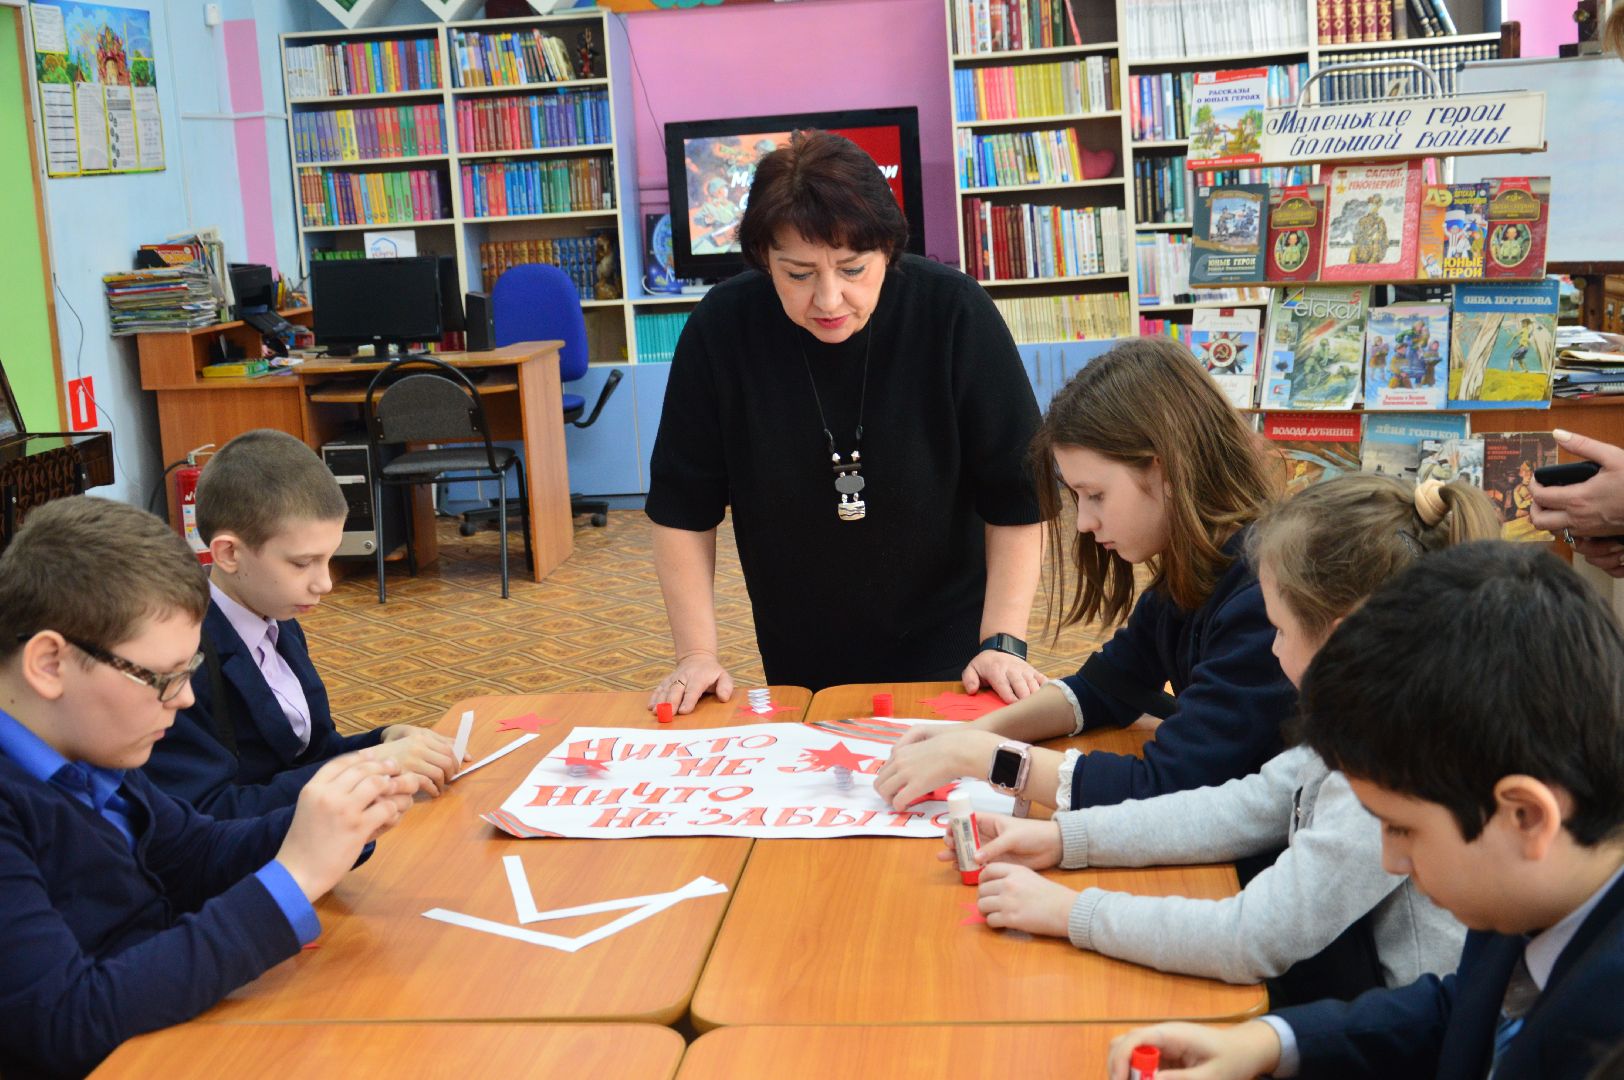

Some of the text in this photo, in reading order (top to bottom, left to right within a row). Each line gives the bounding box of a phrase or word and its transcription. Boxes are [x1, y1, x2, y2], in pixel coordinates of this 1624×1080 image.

[1208, 88, 1250, 96] РАССКАЗЫ
[1231, 94, 1261, 102] ГЕРОЯХ
[1266, 103, 1506, 135] Маленькие герои
[1290, 124, 1512, 156] большой войны
[1208, 257, 1256, 267] ЮНЫЕ ГЕРОИ
[1444, 256, 1484, 268] ЮНЫЕ
[1443, 267, 1483, 279] ГЕРОИ
[1463, 295, 1553, 305] ЗИНА ПОРТНОВА
[1272, 426, 1354, 438] ВОЛОДЯ ДУБИНИН
[1409, 428, 1460, 440] ГОЛИКОВ
[670, 755, 765, 777] НЕ
